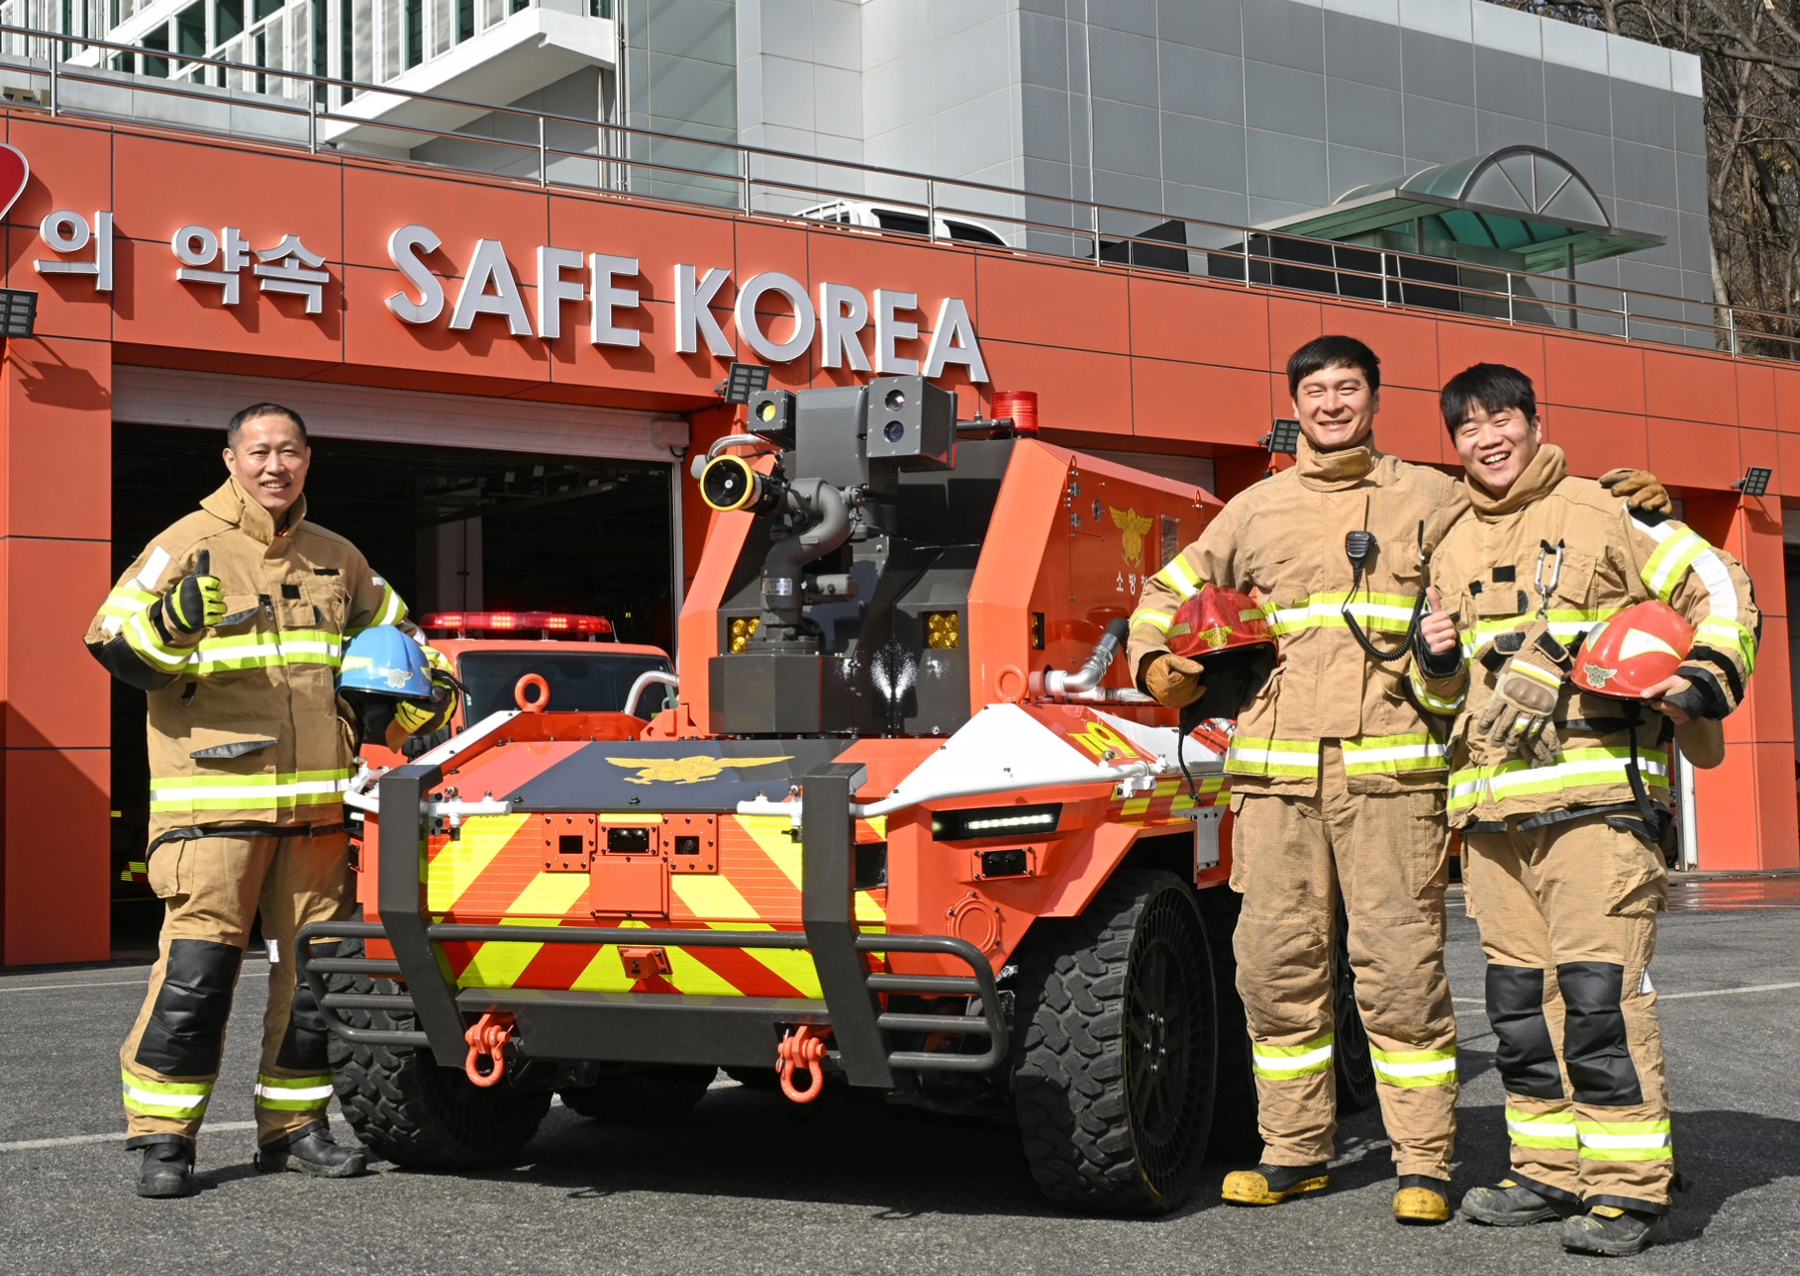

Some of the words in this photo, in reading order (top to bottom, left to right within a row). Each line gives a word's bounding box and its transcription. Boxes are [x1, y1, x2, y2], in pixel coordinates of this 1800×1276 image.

[33, 209, 114, 292] 의
[171, 224, 330, 314] 약속
[384, 224, 640, 347] SAFE
[674, 263, 989, 383] KOREA
